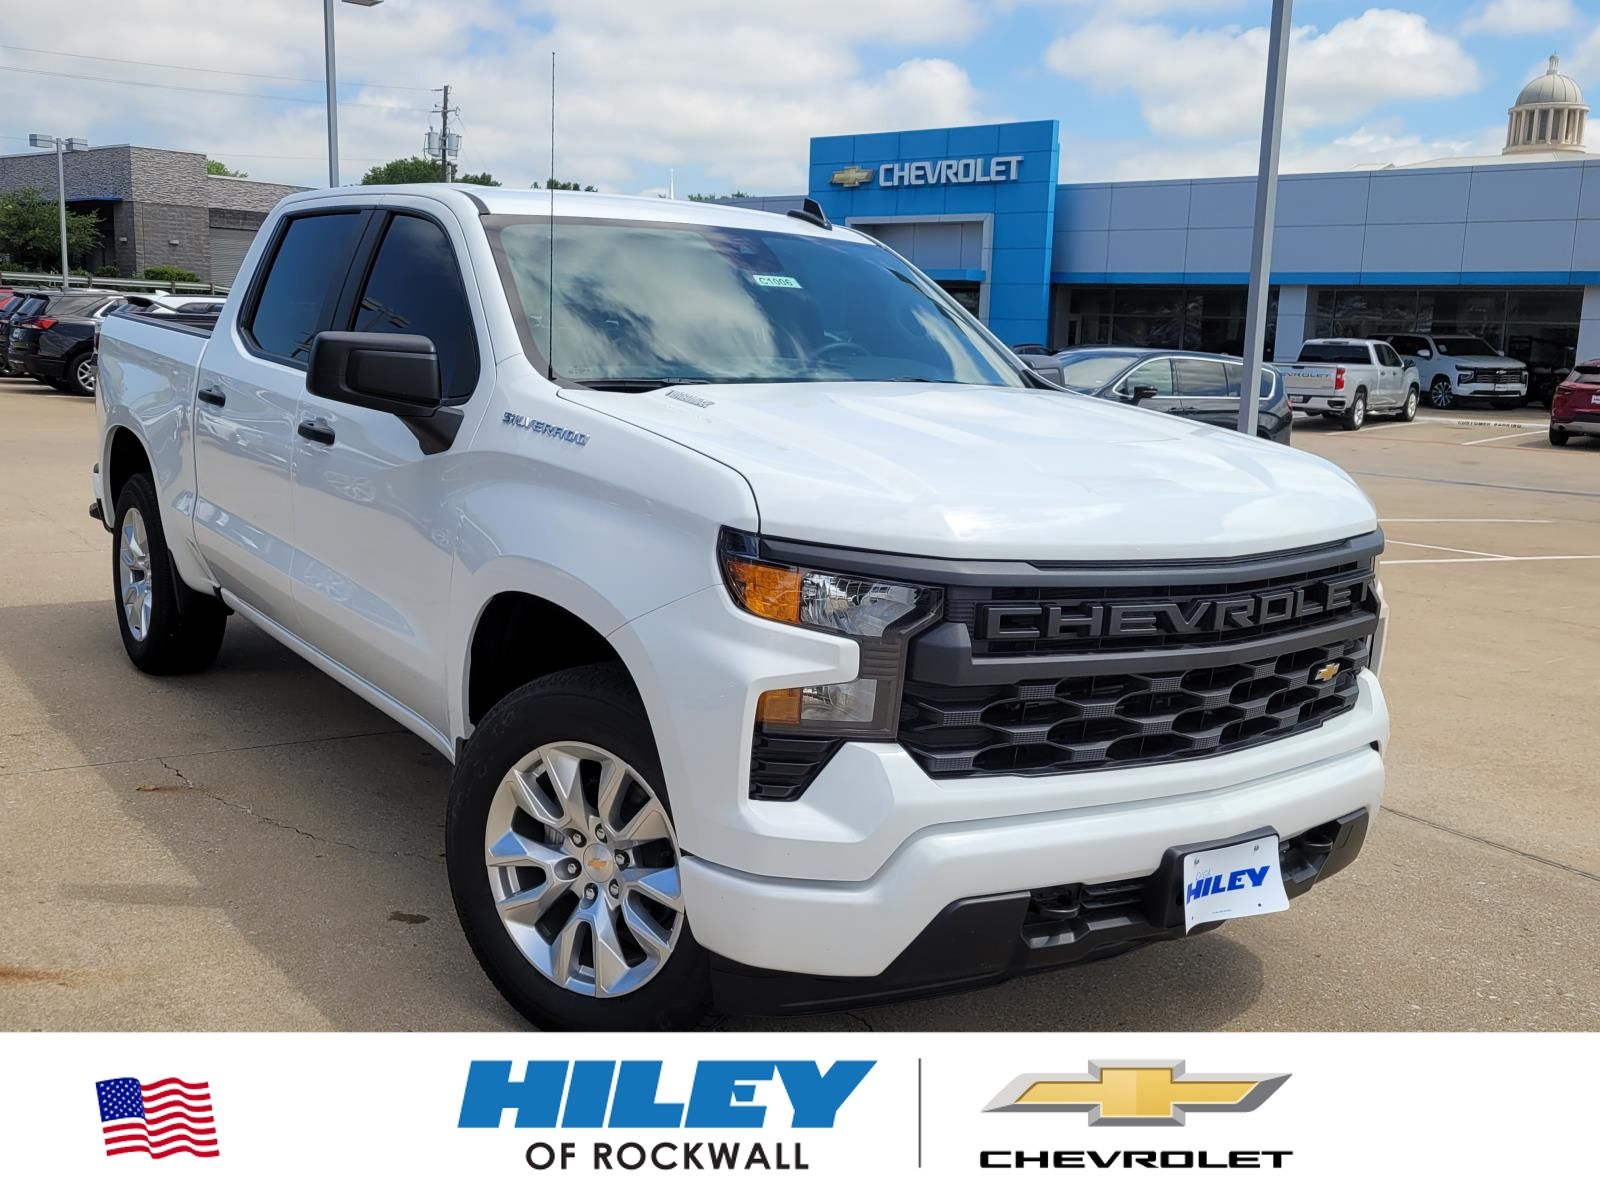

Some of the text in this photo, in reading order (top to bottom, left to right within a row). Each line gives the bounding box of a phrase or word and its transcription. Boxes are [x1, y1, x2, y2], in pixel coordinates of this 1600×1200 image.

[879, 155, 1024, 187] CHEVROLET
[502, 411, 590, 446] SILVERADO
[978, 573, 1376, 640] CHEVROLET
[1186, 865, 1271, 905] HILEY
